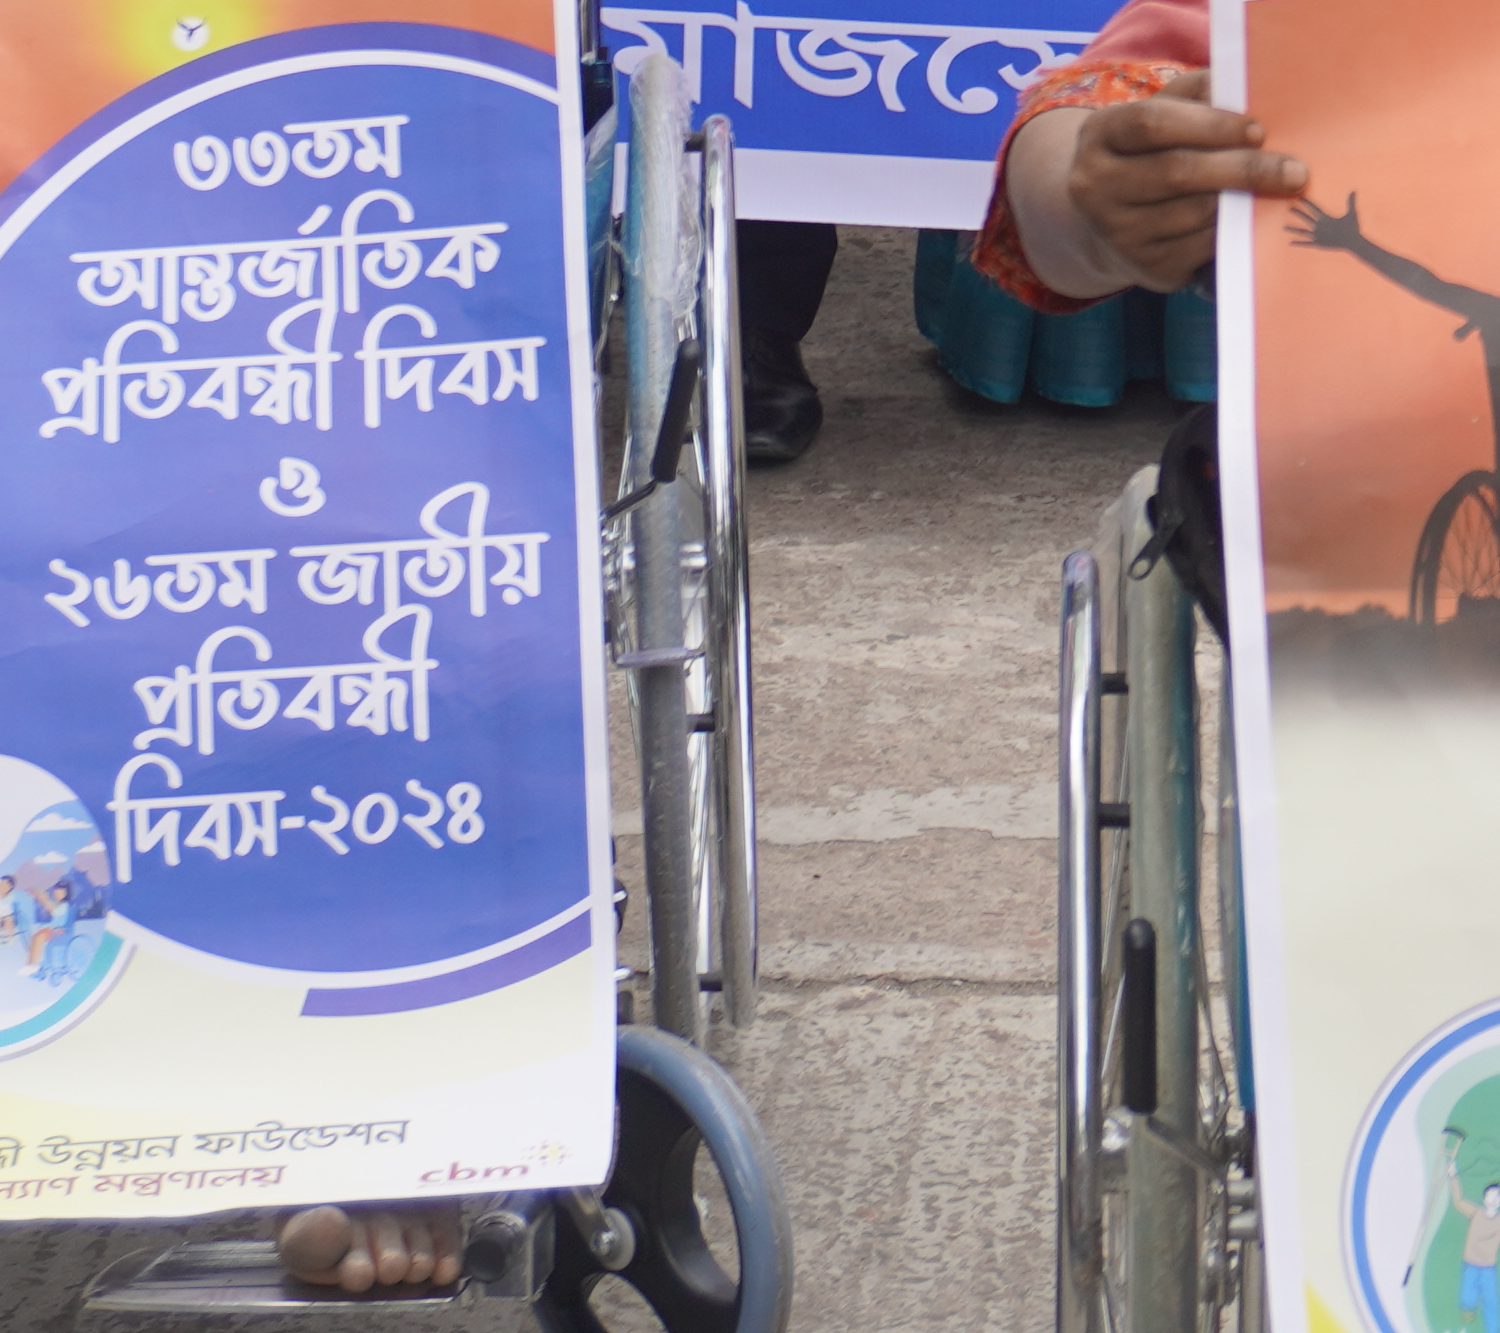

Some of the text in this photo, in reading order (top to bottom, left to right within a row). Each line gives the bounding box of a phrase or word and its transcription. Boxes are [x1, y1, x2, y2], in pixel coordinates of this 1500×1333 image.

[174, 114, 410, 191] ৩৩তম
[69, 189, 509, 324] আন্তর্জাতিক
[39, 299, 548, 444] প্রতিবন্ধী দিবস
[258, 457, 327, 519] ও
[44, 481, 551, 629] ২৬তম জাতীয়
[133, 603, 440, 756] প্রতিবন্ধী
[106, 752, 485, 884] দিবস-২০২৪
[36, 1135, 181, 1171] উন্নয়ন
[92, 1164, 288, 1203] মন্ত্রণালয়
[419, 1162, 530, 1184] cbm
